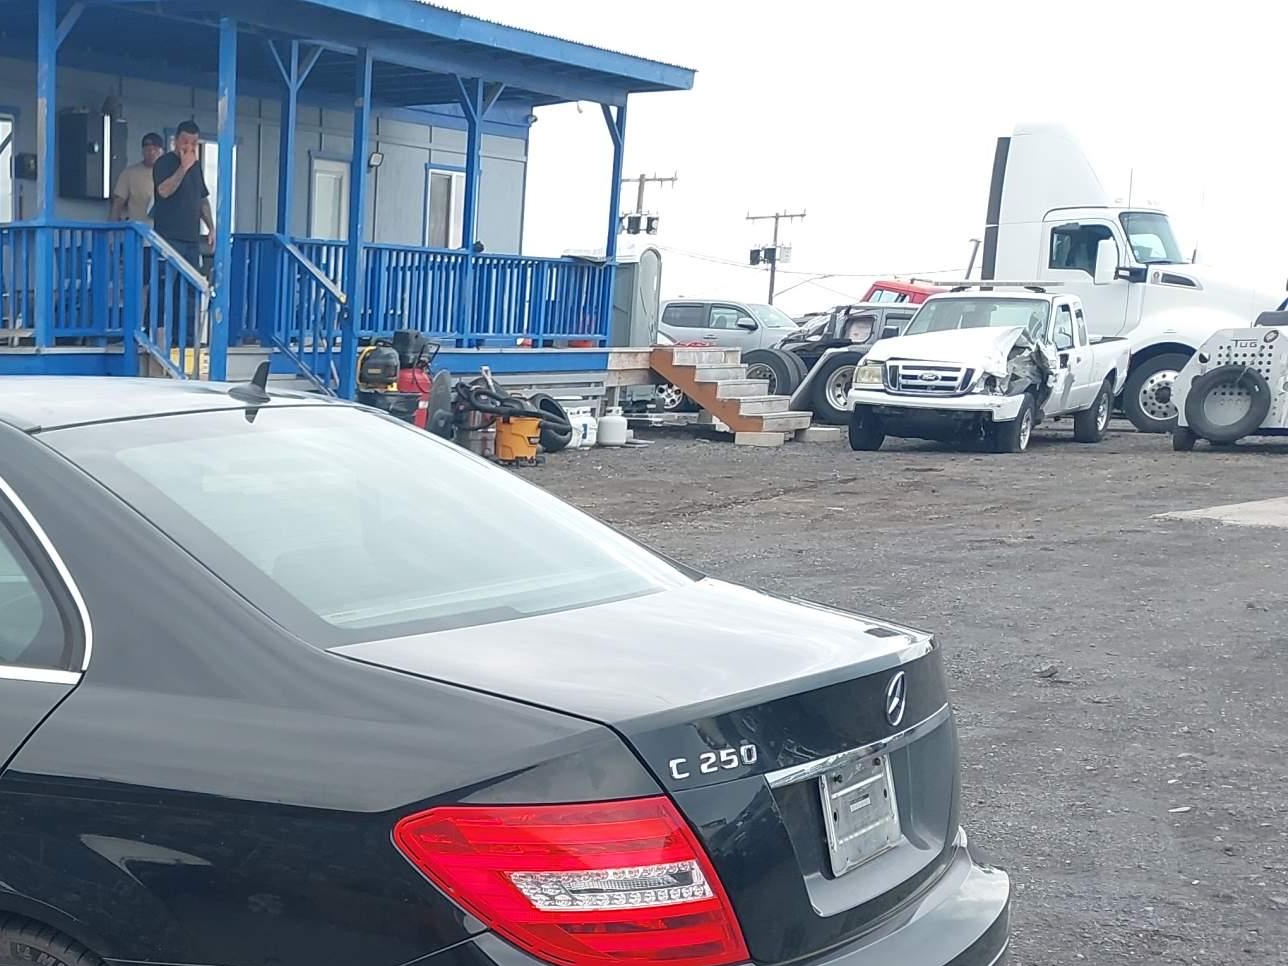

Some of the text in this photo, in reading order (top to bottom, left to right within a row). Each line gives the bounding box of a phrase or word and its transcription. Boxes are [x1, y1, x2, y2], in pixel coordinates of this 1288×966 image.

[1231, 339, 1258, 348] TUG
[669, 744, 757, 779] C 250
